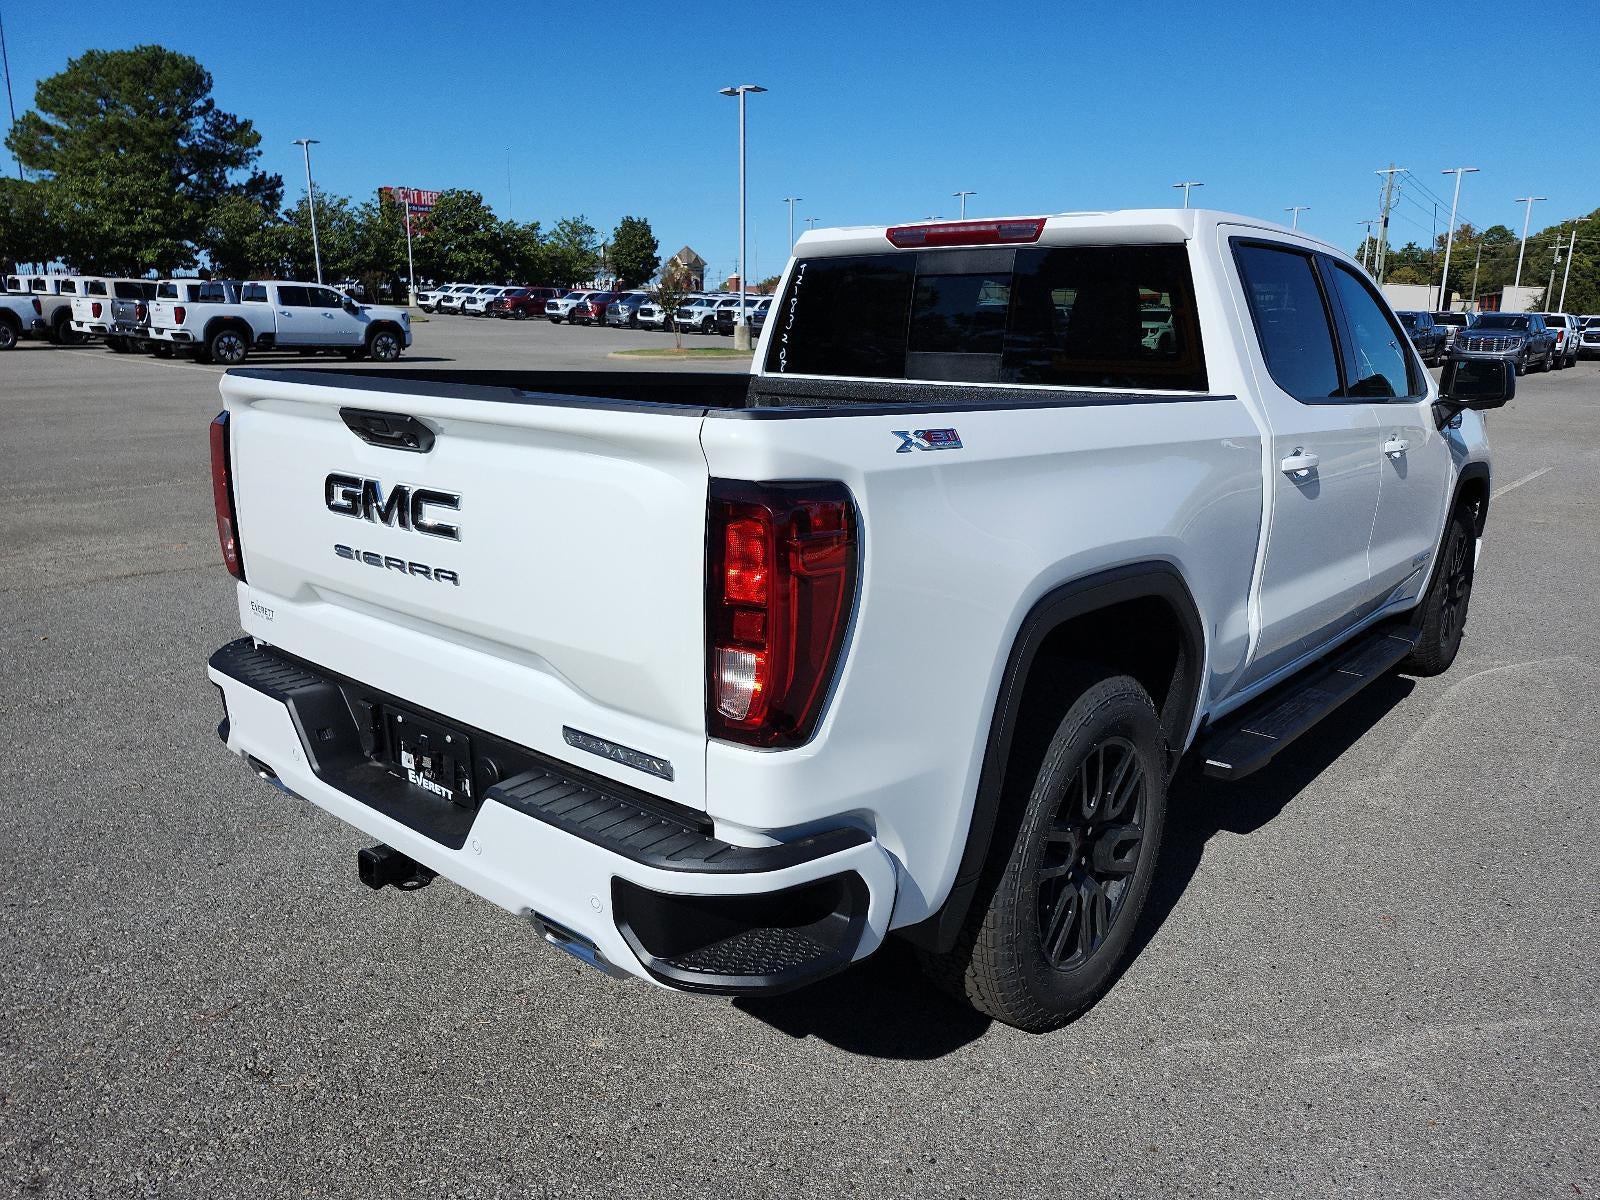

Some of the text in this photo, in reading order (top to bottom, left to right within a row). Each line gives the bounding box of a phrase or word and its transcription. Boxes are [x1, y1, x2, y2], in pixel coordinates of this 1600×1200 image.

[421, 191, 441, 206] HER
[325, 471, 463, 542] GMC
[334, 543, 461, 587] SIERRA
[407, 768, 453, 801] EVERETT
